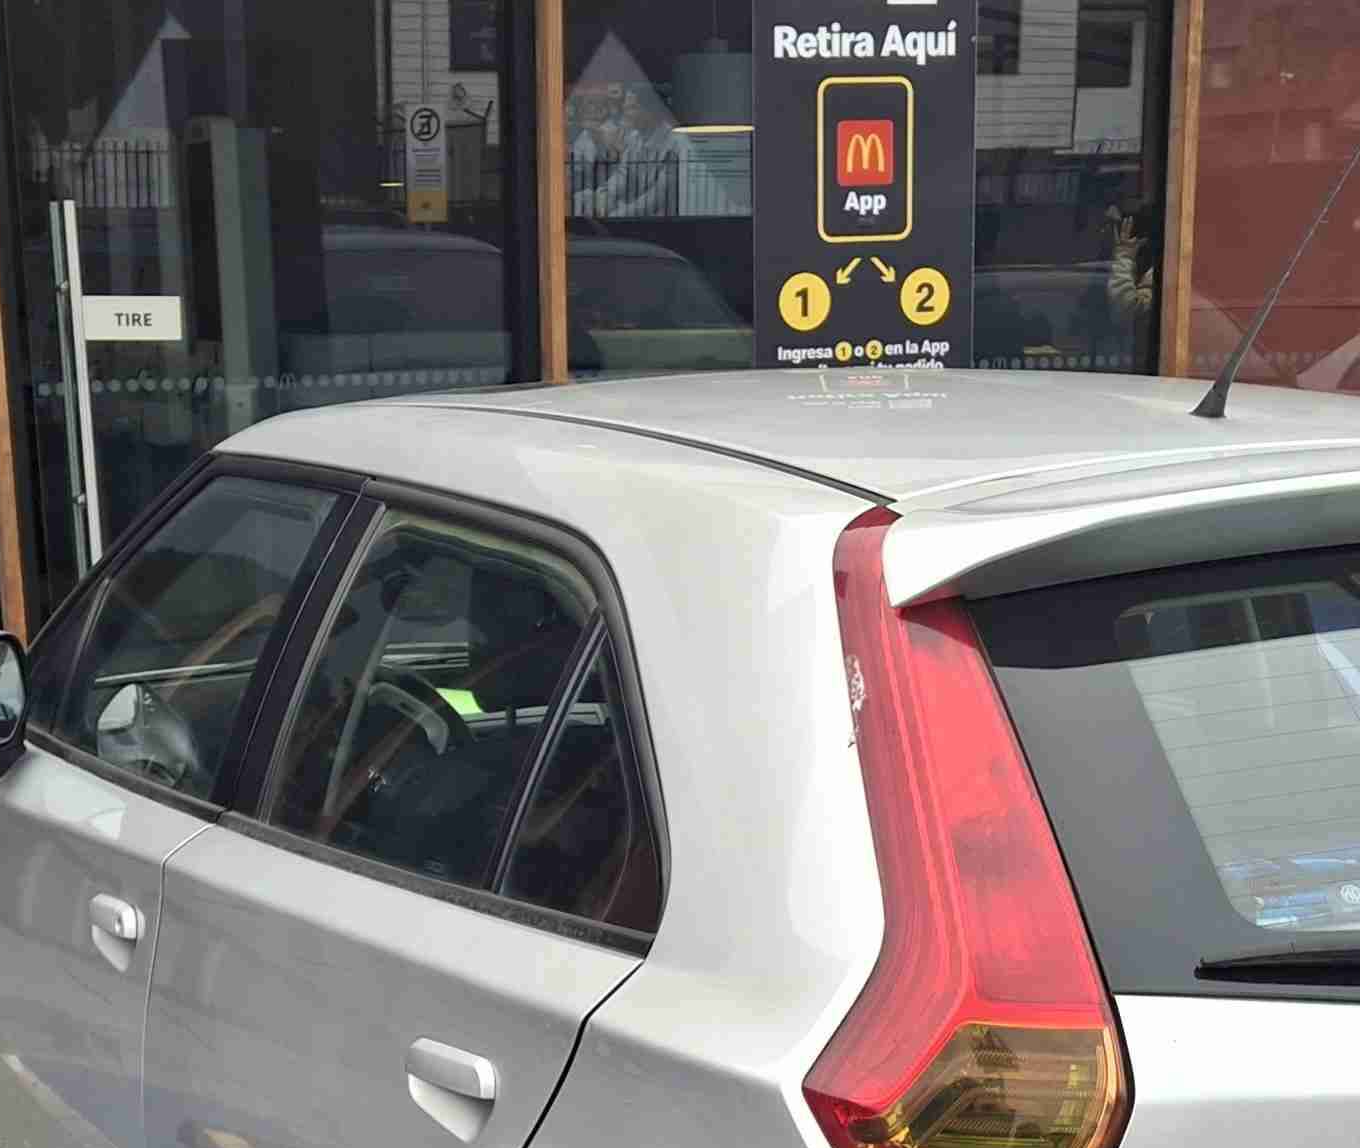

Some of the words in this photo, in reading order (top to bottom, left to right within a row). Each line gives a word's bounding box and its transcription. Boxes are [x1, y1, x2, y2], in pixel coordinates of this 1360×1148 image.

[773, 22, 875, 58] Retira
[880, 20, 957, 65] Aquí
[843, 191, 887, 215] App
[793, 287, 809, 318] 1
[915, 282, 935, 313] 2
[114, 312, 152, 327] TIRE
[777, 345, 833, 364] Ingresa
[854, 345, 864, 357] o
[885, 343, 903, 355] en
[905, 340, 919, 354] la
[921, 339, 950, 356] App
